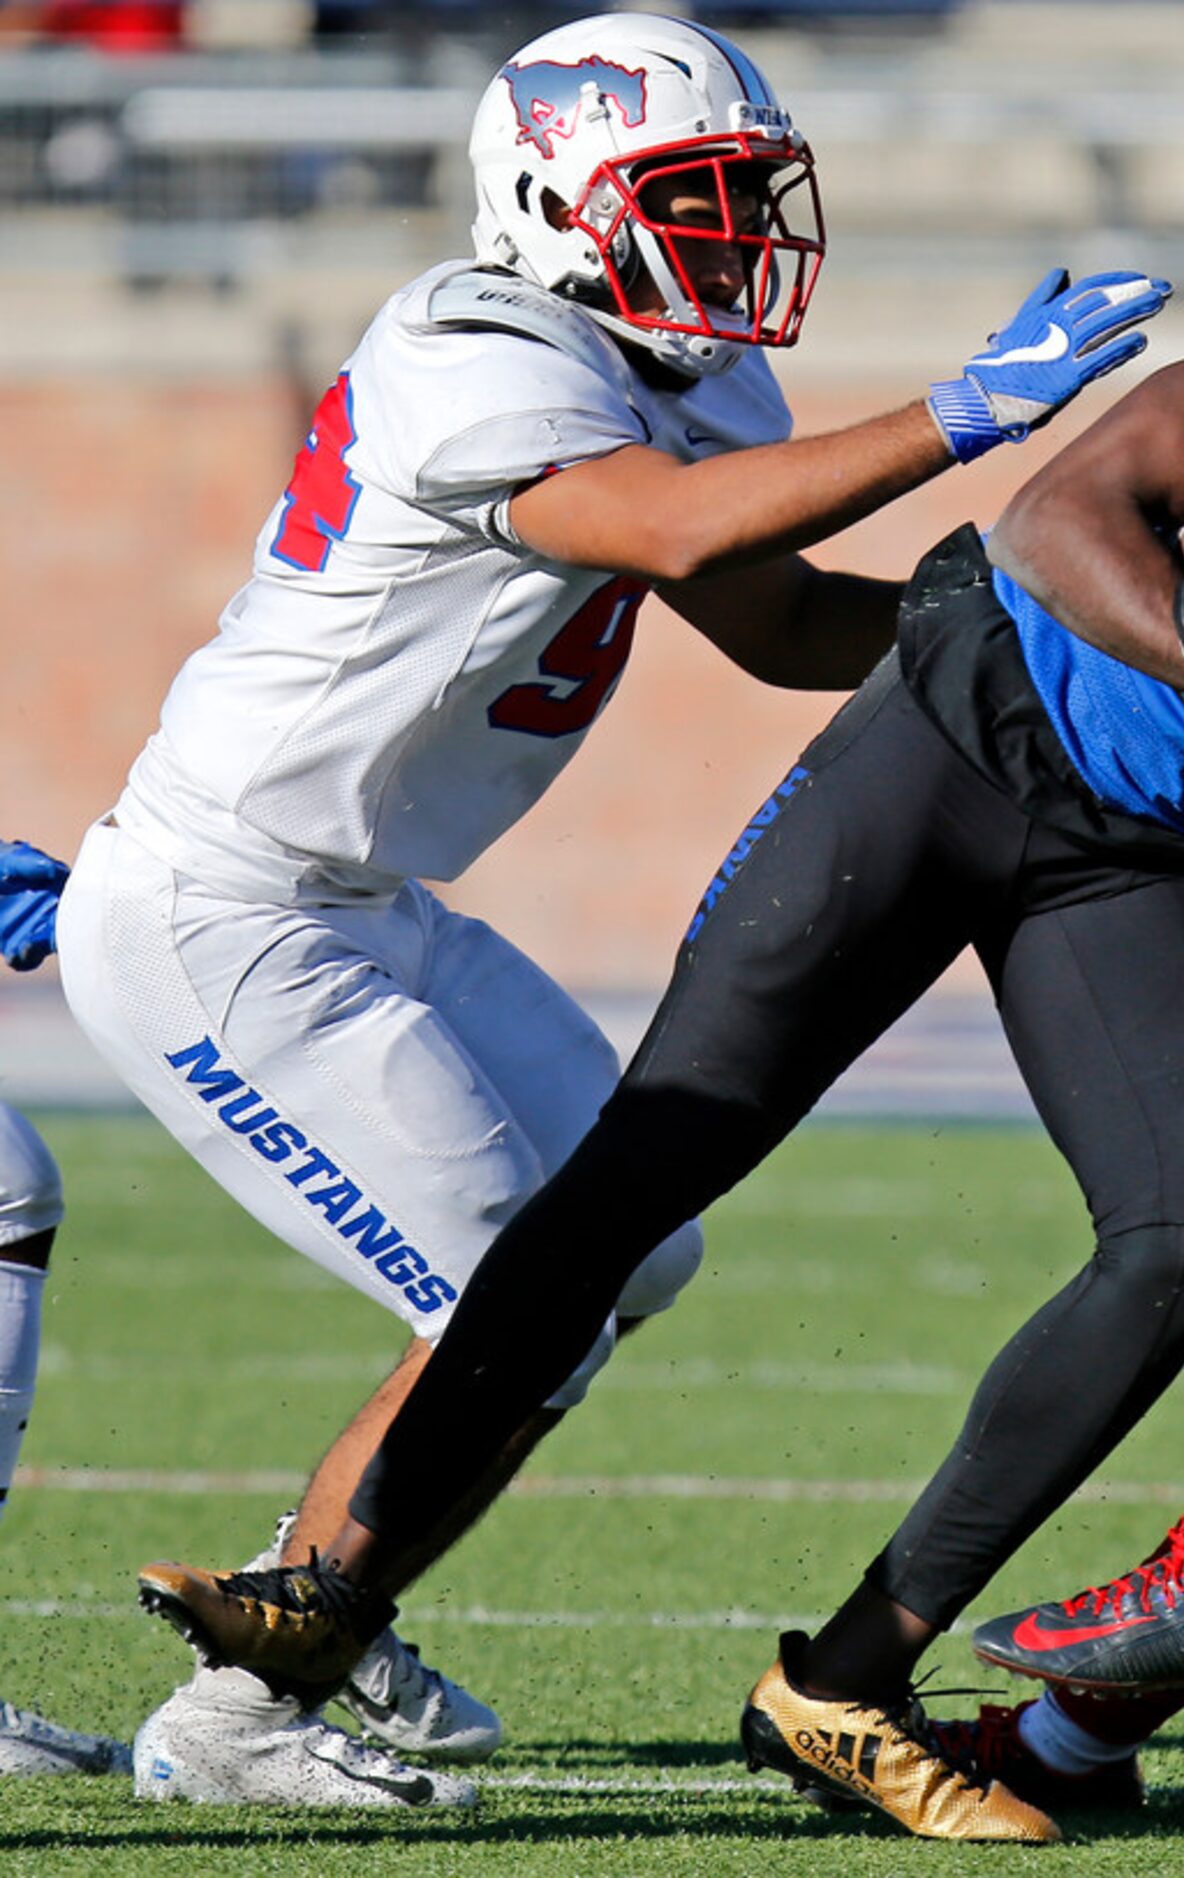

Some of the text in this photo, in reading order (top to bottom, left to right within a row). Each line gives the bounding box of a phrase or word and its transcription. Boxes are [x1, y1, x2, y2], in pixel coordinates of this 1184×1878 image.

[269, 371, 363, 573] 4
[486, 574, 653, 738] 9
[164, 1034, 459, 1313] MUSTANGS
